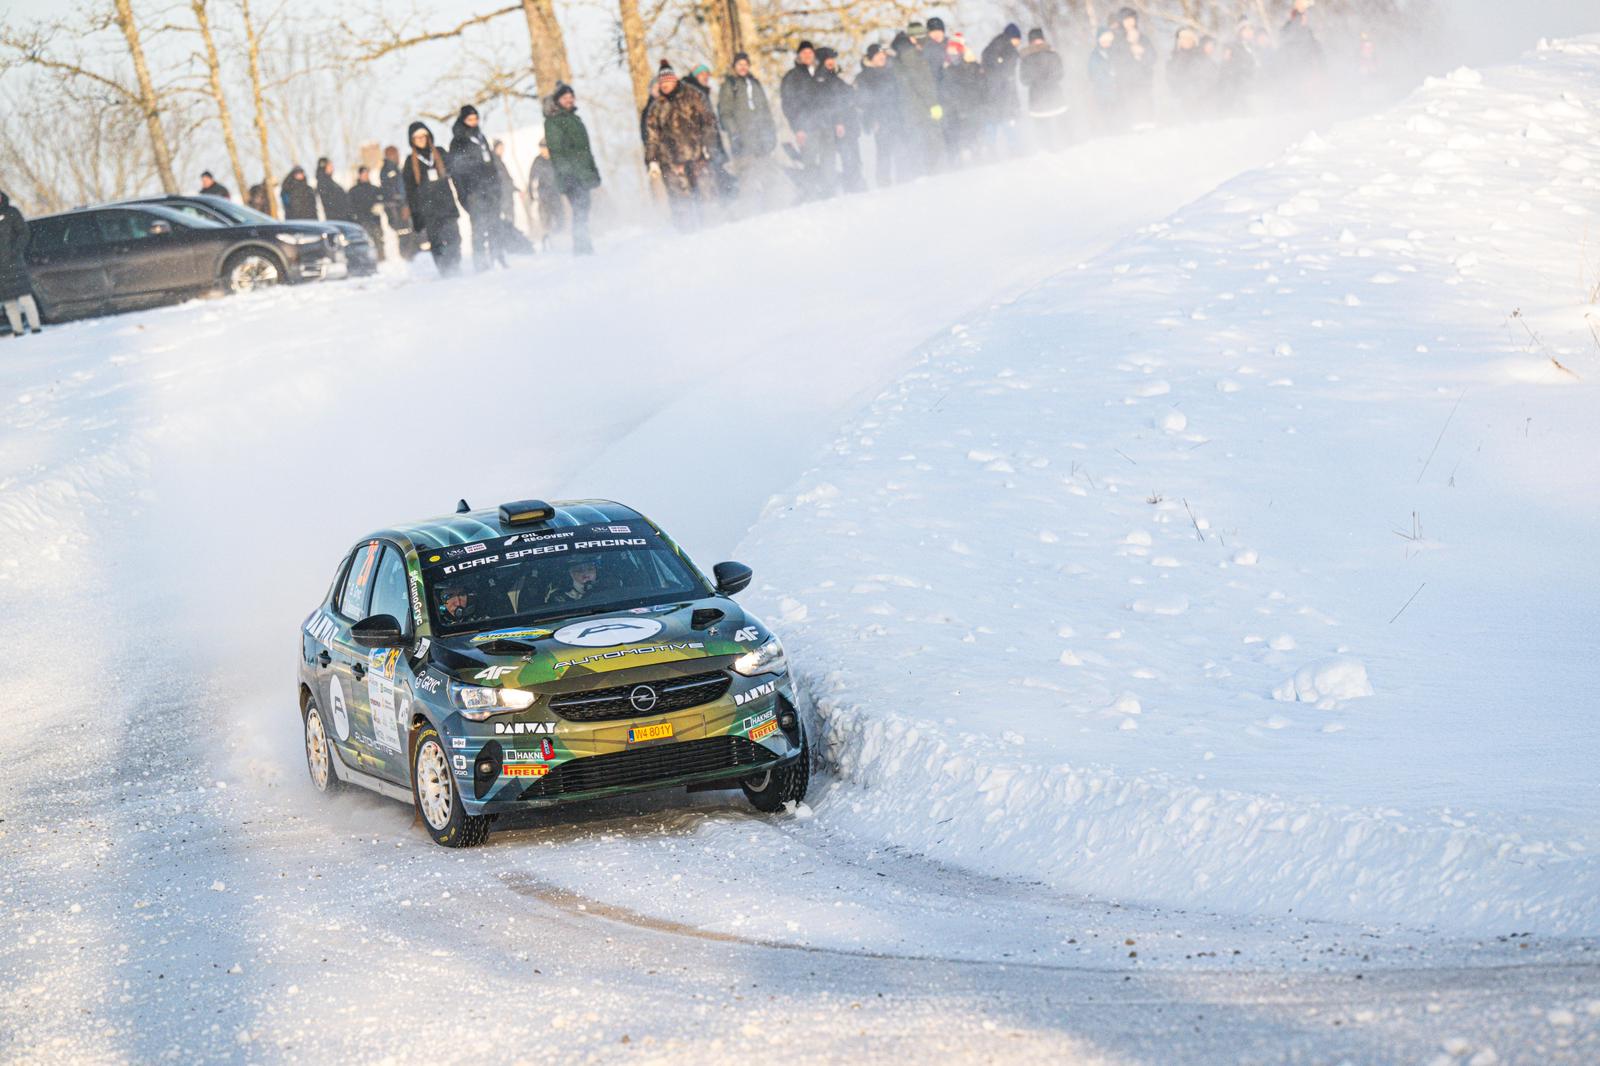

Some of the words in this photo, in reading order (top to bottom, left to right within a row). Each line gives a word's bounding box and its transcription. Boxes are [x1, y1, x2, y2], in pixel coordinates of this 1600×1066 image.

[523, 531, 575, 543] RECOVERY
[458, 555, 500, 571] CAR
[505, 543, 569, 560] SPEED
[574, 538, 647, 549] RACING
[410, 569, 423, 626] #BrunoGryc
[553, 642, 705, 670] AUTOMOTIVE
[649, 724, 671, 737] 801Y
